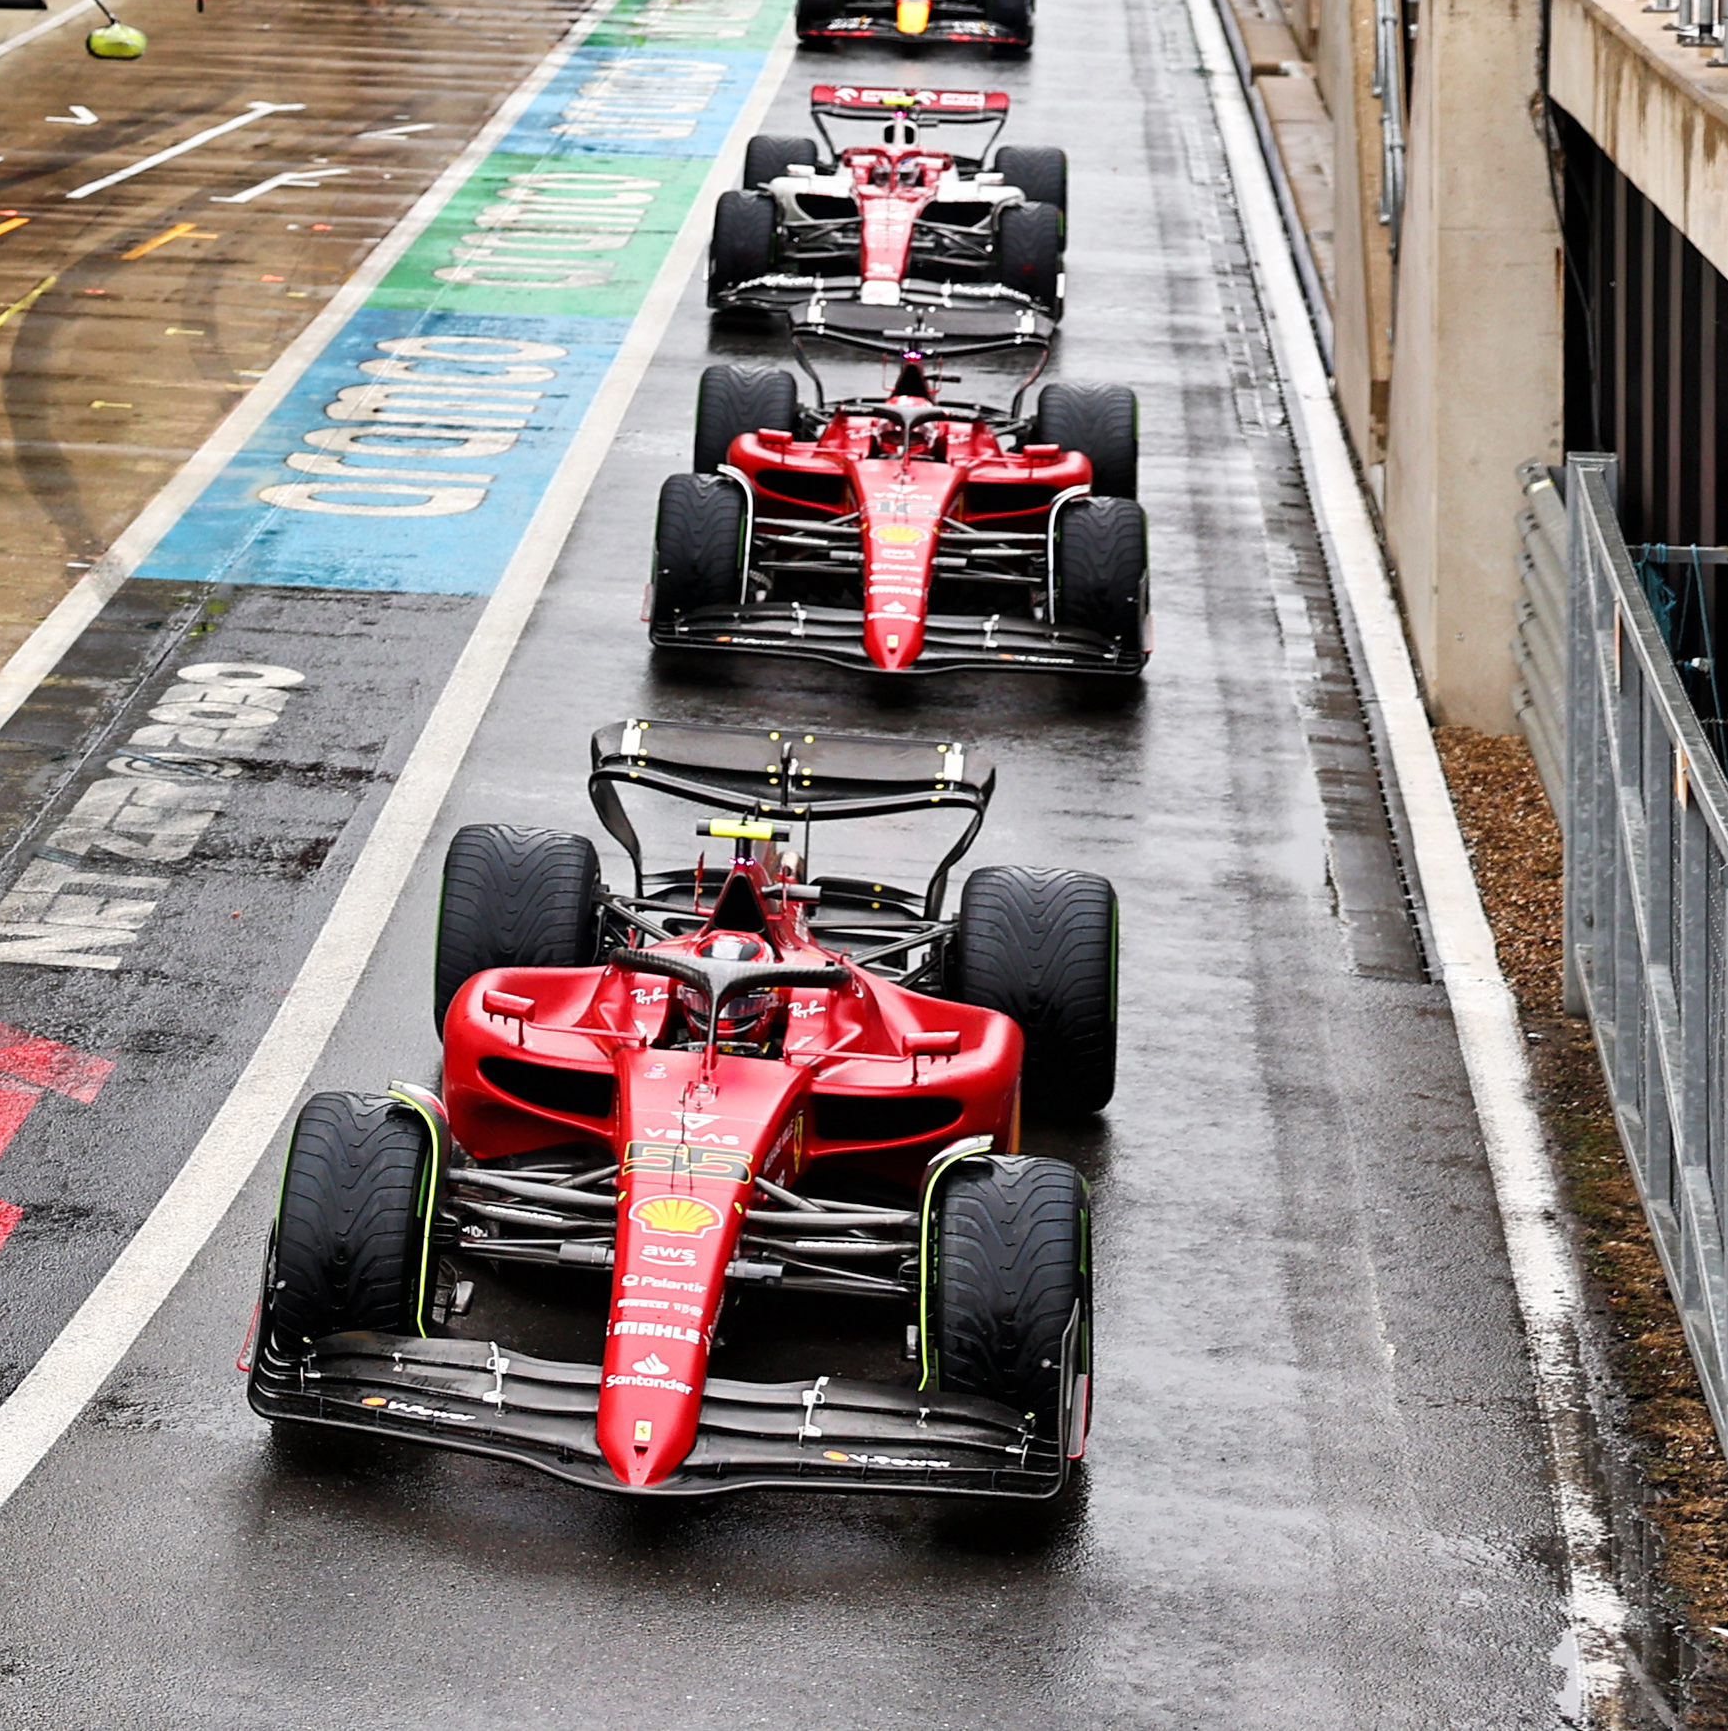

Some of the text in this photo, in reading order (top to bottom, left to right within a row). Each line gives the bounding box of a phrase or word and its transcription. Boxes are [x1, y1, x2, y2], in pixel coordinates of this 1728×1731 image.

[432, 171, 663, 289] aramco
[257, 335, 569, 518] aramco
[643, 1127, 740, 1146] VELAS
[621, 1140, 755, 1185] 55
[641, 1244, 697, 1261] aws
[640, 1276, 708, 1294] Palantir
[613, 1321, 701, 1345] MAHLE
[605, 1374, 694, 1395] Santander
[387, 1400, 477, 1422] V-Power
[848, 1453, 951, 1468] V-Power
